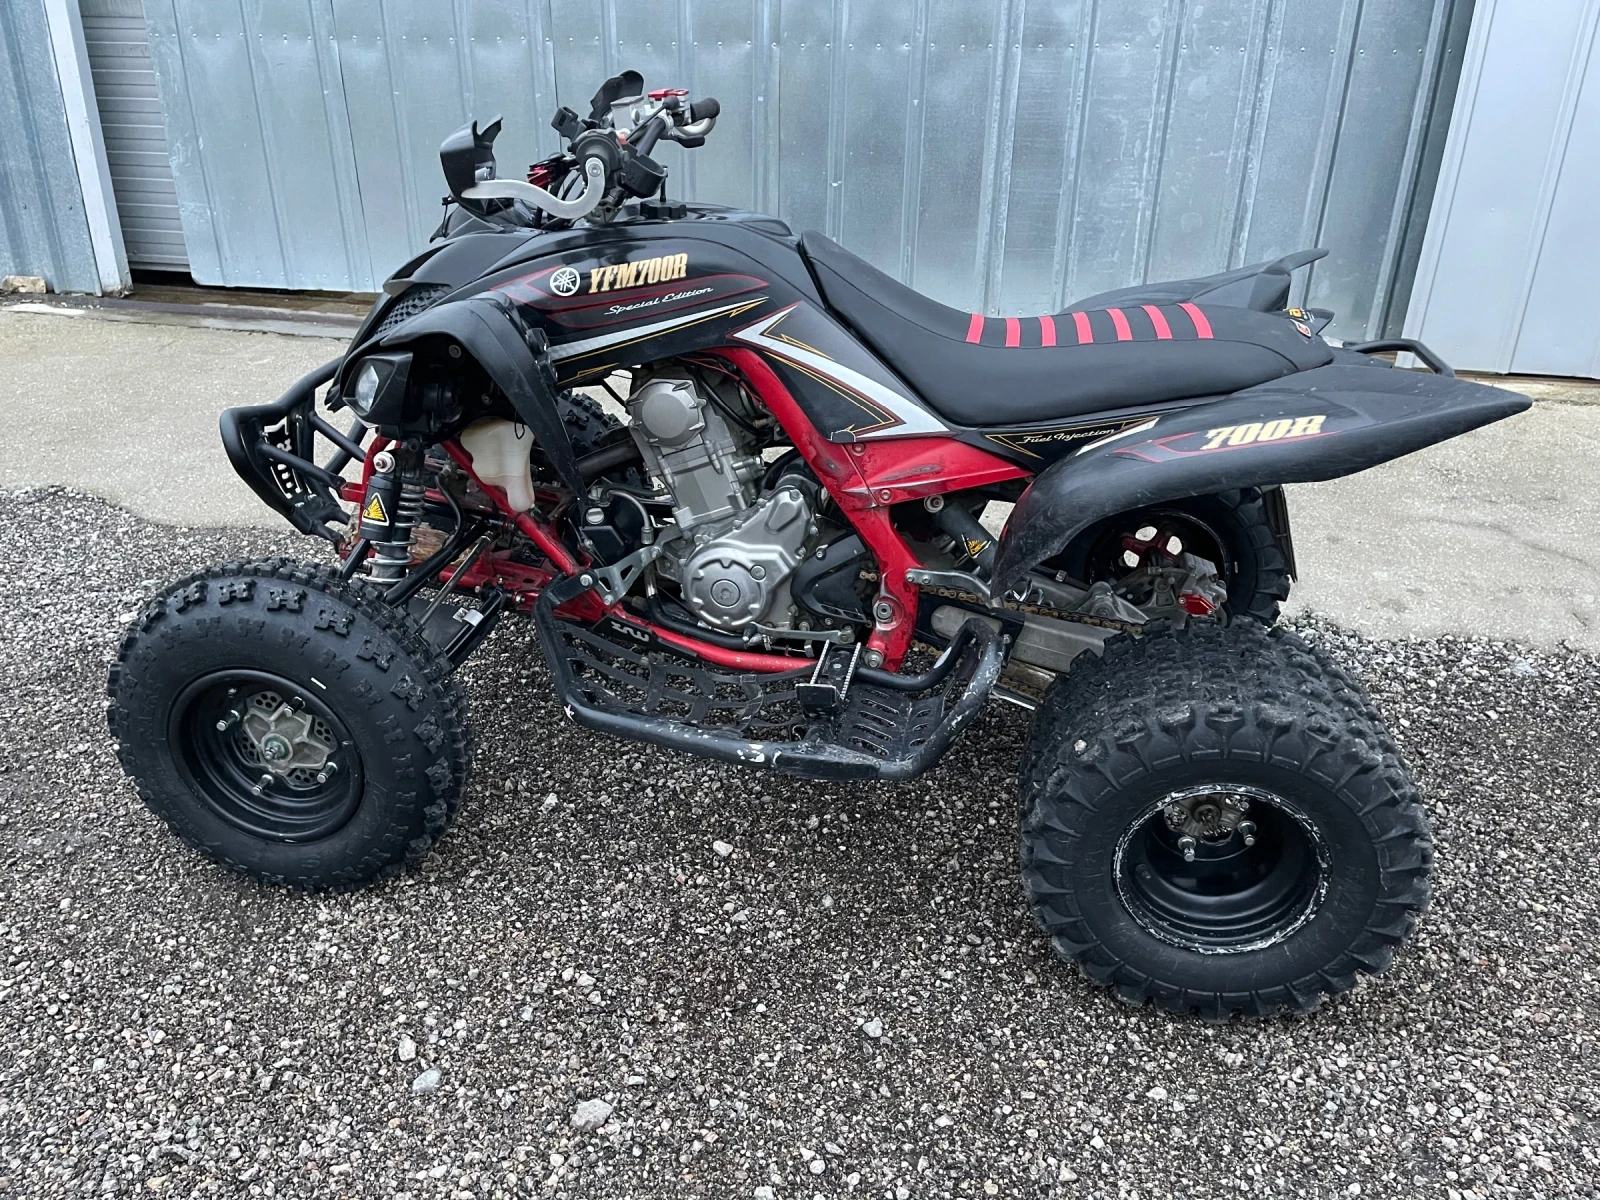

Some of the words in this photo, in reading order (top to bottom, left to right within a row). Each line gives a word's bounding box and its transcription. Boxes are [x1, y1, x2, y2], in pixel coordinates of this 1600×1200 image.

[588, 253, 688, 293] YFM700R
[605, 297, 660, 315] Special
[662, 286, 713, 304] Edition
[1016, 434, 1053, 445] Fuel
[1053, 428, 1115, 443] Injection
[1200, 416, 1327, 450] 700R
